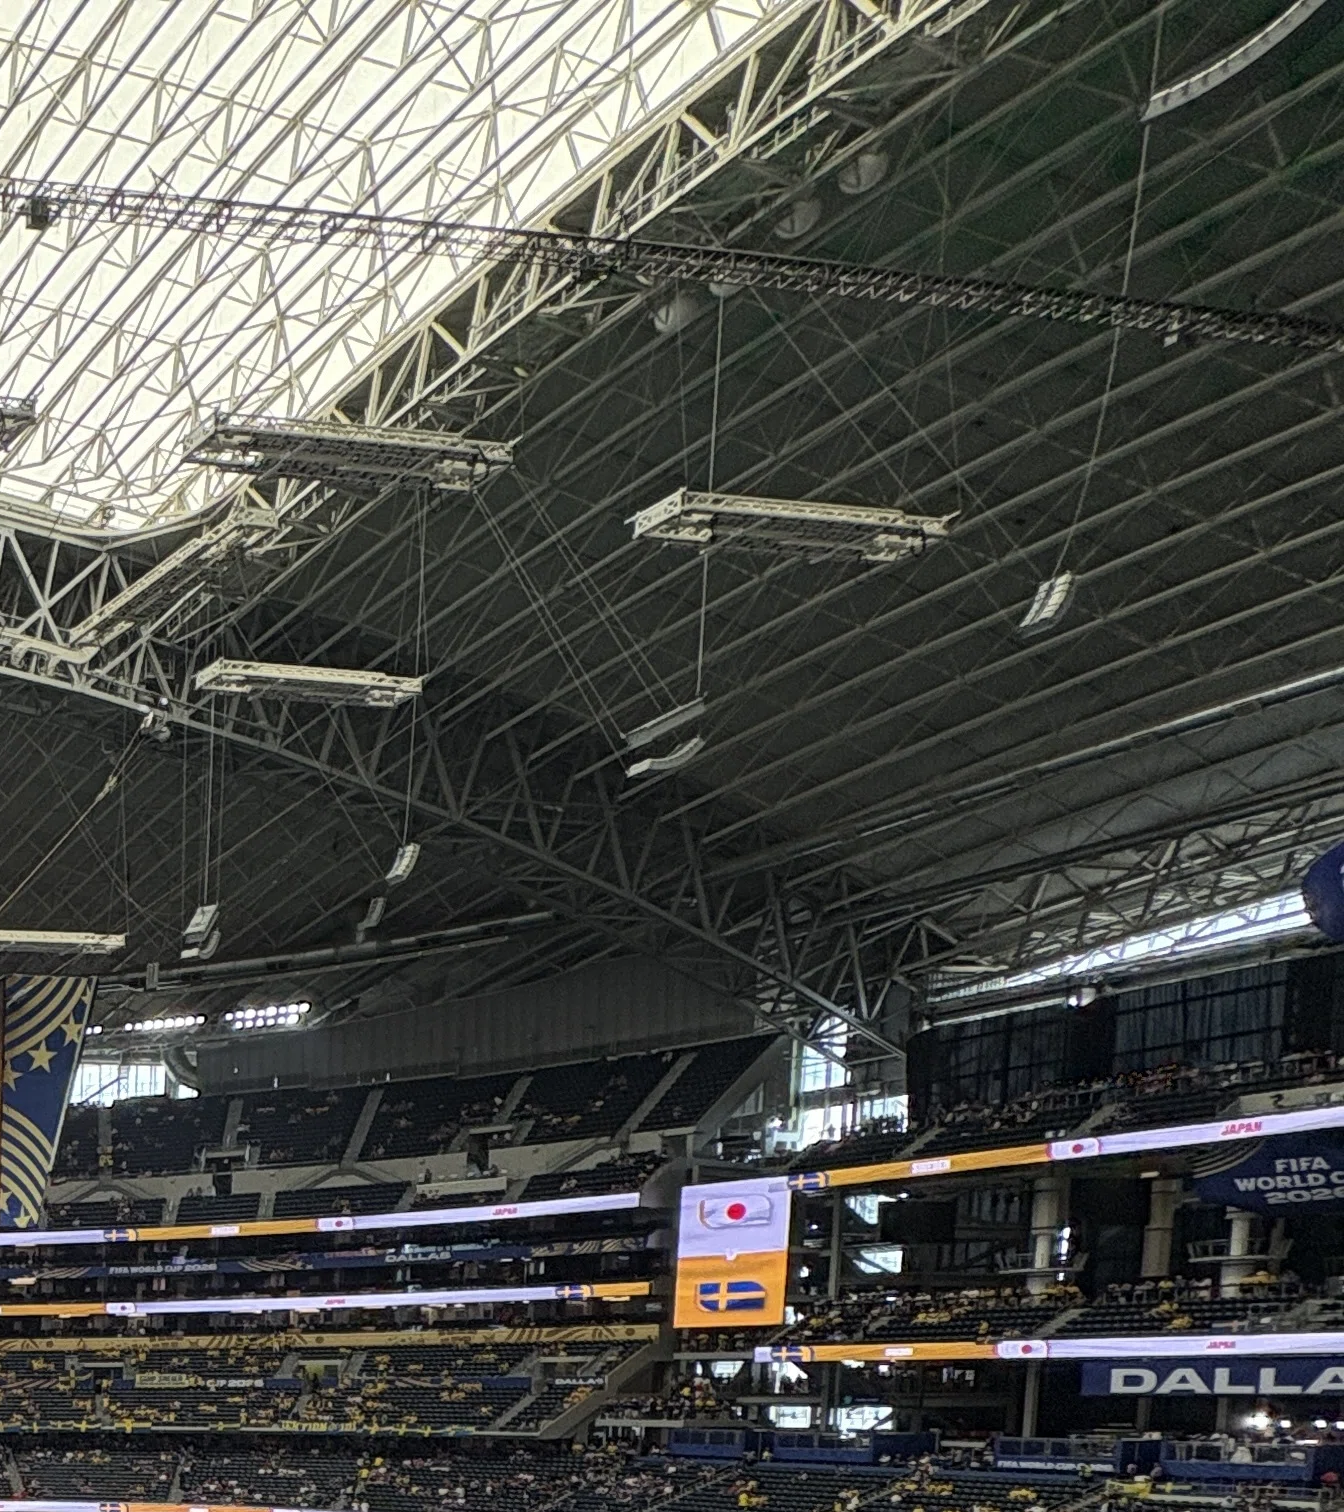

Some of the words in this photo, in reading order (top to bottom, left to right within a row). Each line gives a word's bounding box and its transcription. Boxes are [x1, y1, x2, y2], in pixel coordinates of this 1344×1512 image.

[1221, 1121, 1263, 1136] JAPAN
[1274, 1157, 1331, 1173] FIFA
[1234, 1173, 1327, 1192] WORLD
[385, 1251, 452, 1263] DALLAS
[555, 1377, 604, 1386] DALLAS
